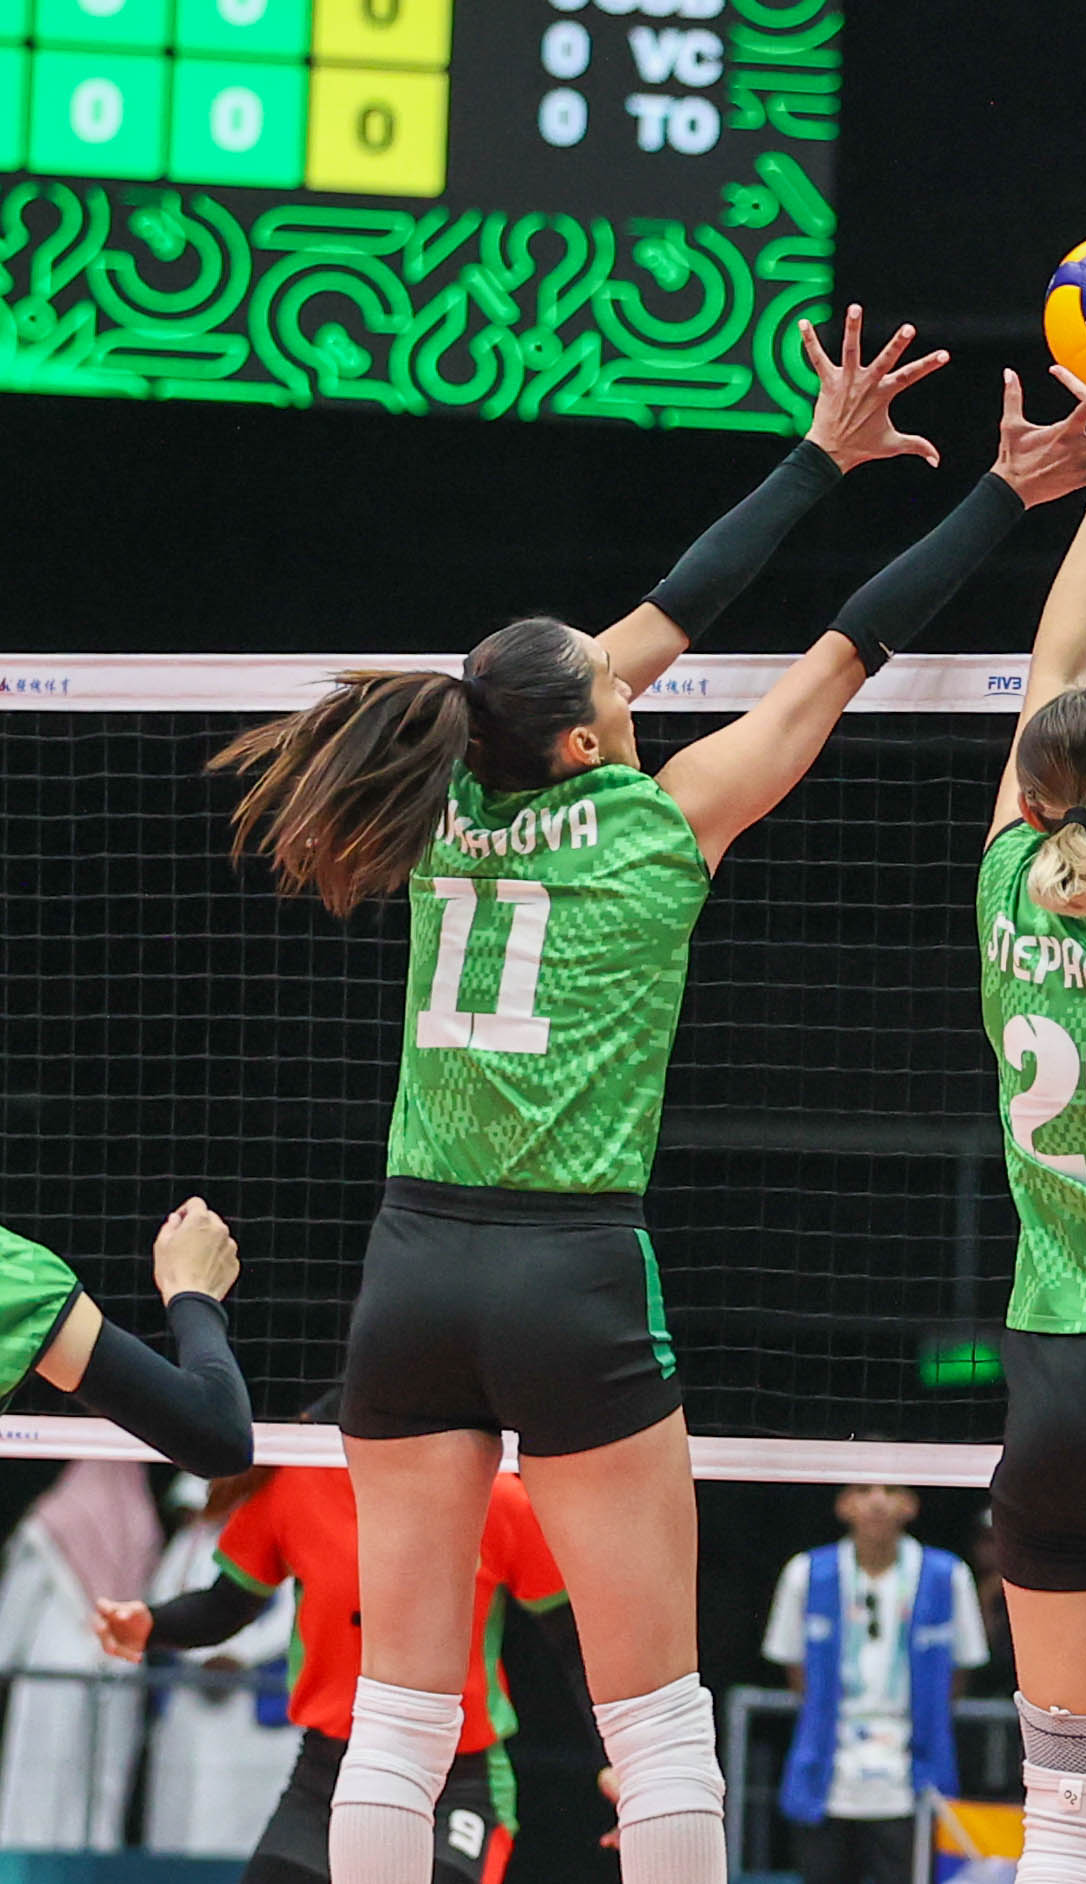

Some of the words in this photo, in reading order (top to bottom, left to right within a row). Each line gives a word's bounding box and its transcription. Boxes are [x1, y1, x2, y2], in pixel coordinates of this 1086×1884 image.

[541, 19, 592, 80] 0
[627, 25, 725, 88] VC
[70, 76, 124, 144] 0
[209, 85, 264, 153] 0
[356, 99, 397, 156] 0
[538, 87, 589, 148] 0
[624, 92, 721, 155] TO
[988, 676, 1022, 690] FIVB
[416, 876, 551, 1055] 11
